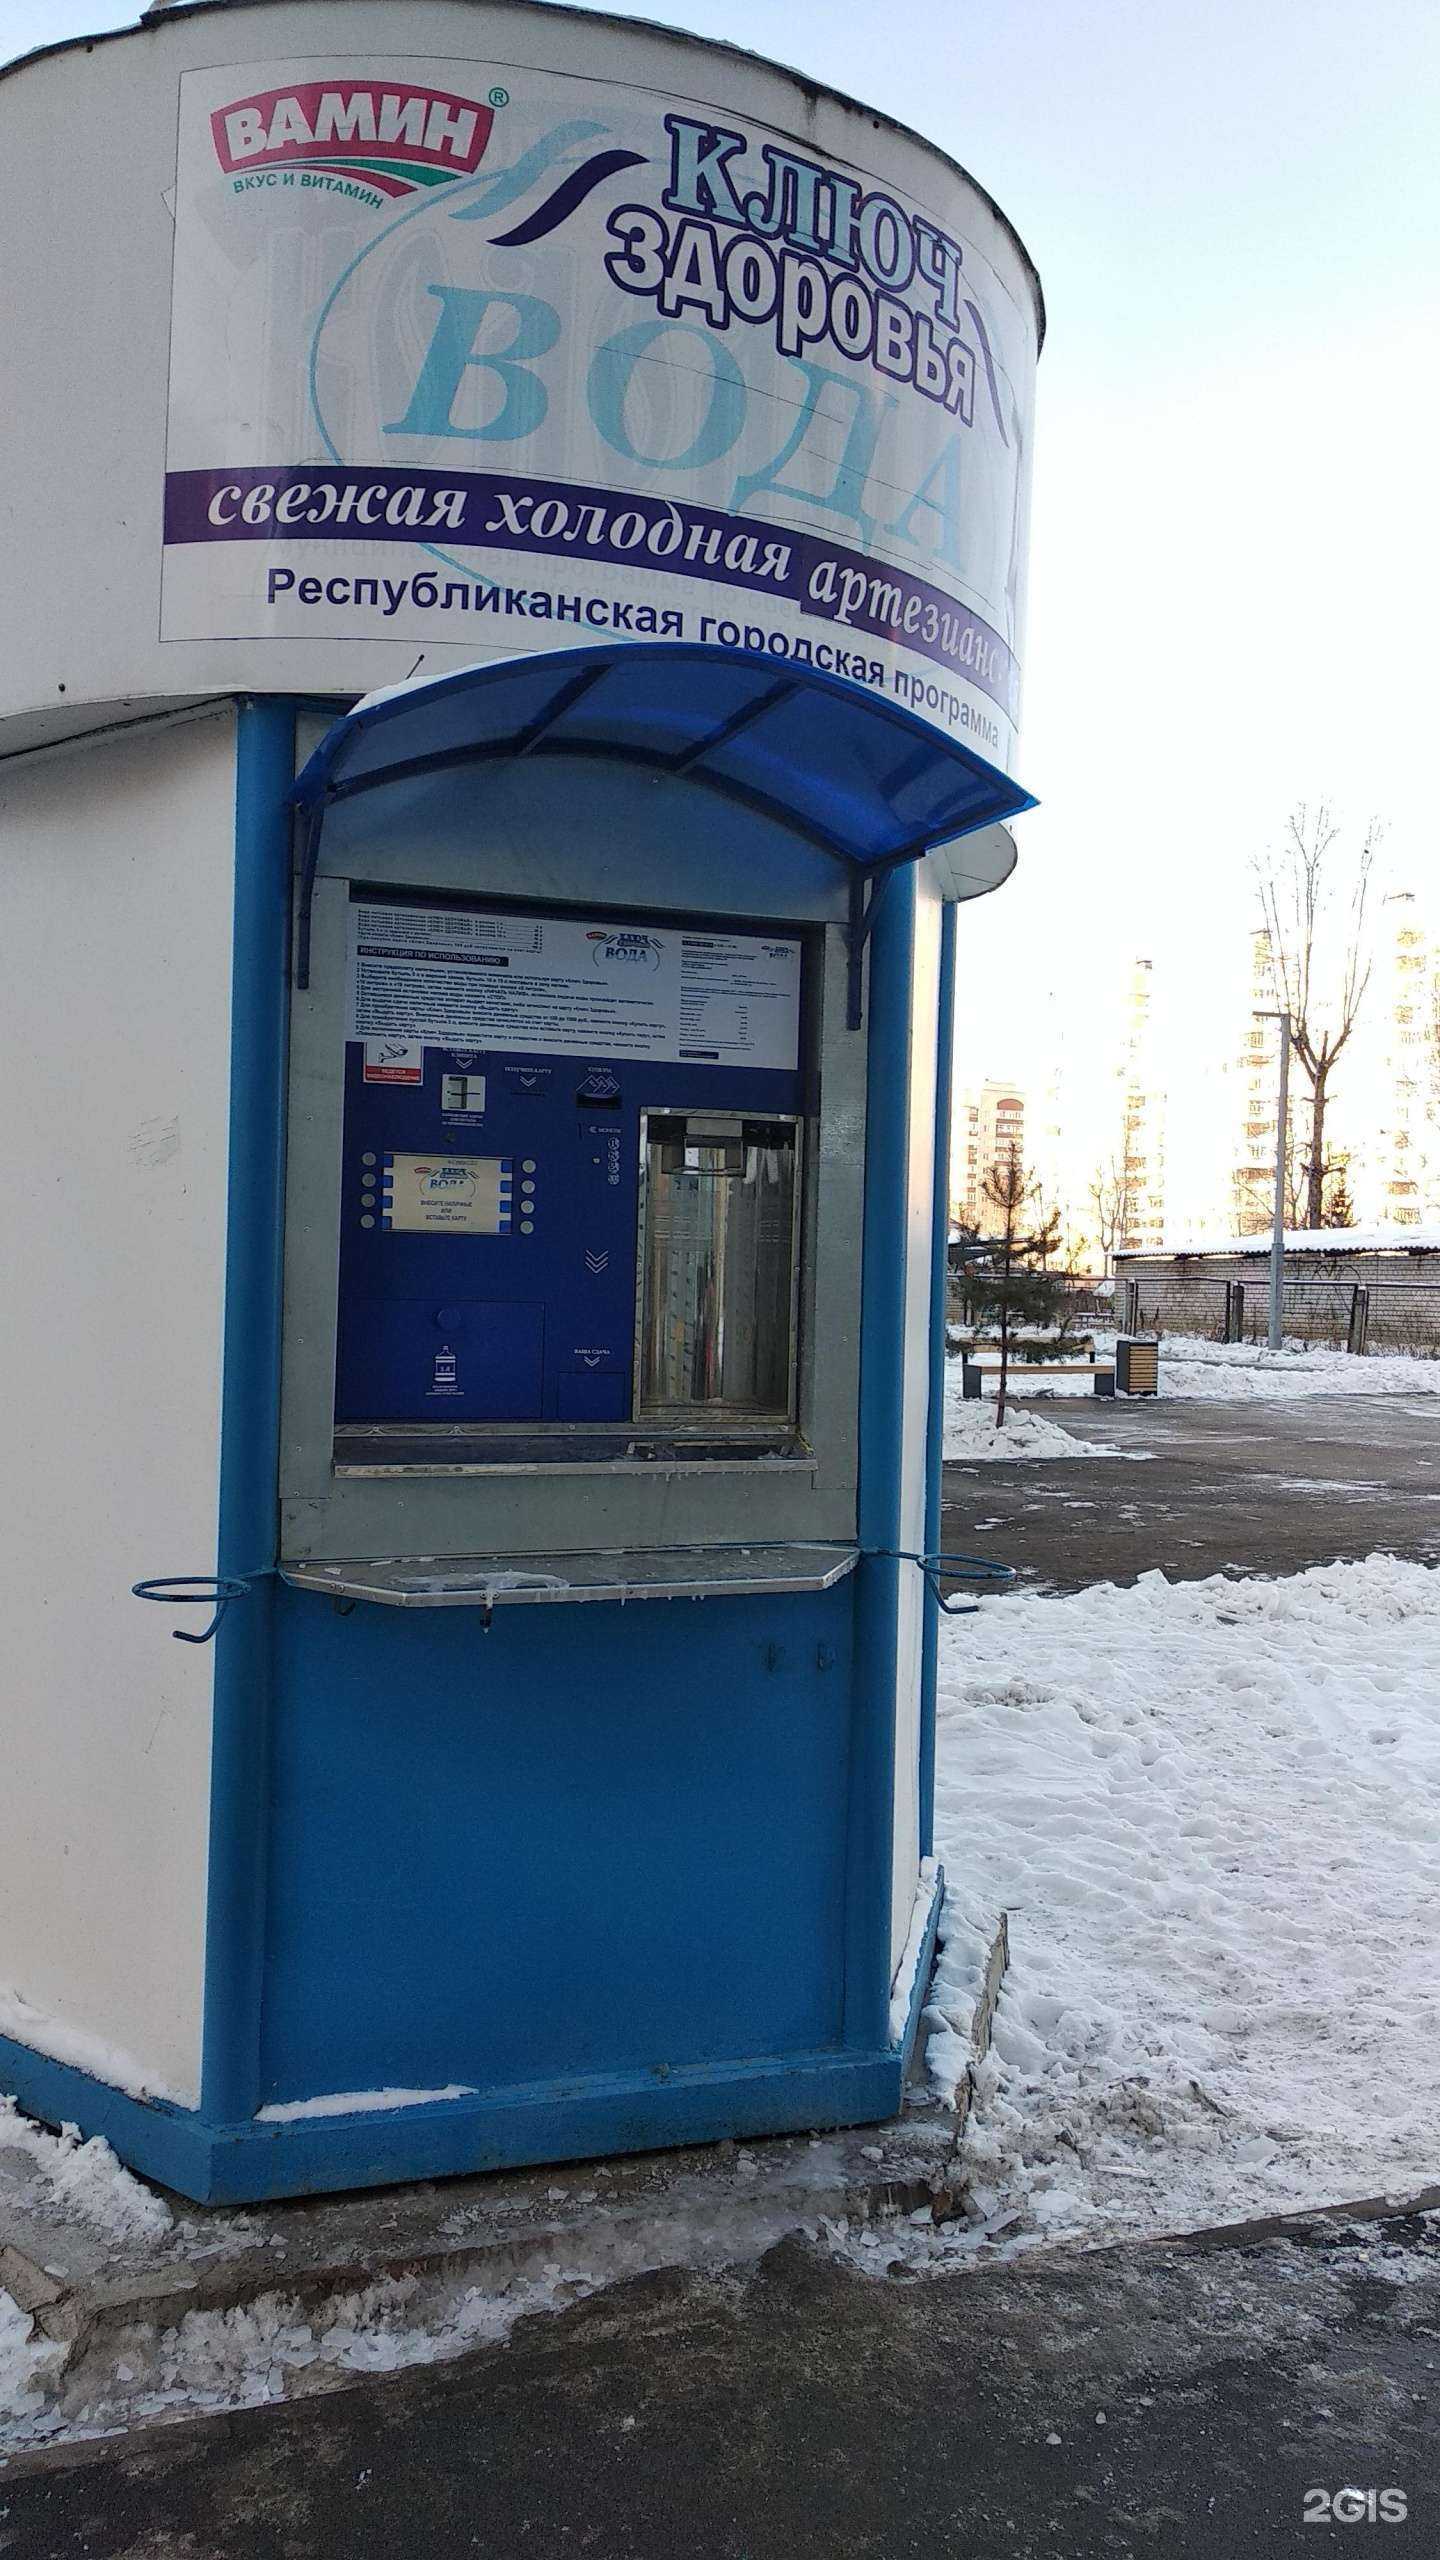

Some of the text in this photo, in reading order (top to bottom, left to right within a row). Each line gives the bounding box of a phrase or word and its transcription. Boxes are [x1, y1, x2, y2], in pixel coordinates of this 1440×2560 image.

[224, 90, 479, 162] ВАМИН
[233, 172, 384, 210] ВКУС И ВИТАМИН
[662, 113, 962, 332] КЛЮЧ
[381, 284, 967, 574] ВОДА
[207, 482, 1003, 684] свежая холодная артезианс
[267, 567, 1000, 750] Республиканская городская программа
[360, 947, 413, 957] ИНСТРУКЦИЯ
[605, 947, 647, 962] ВОДА
